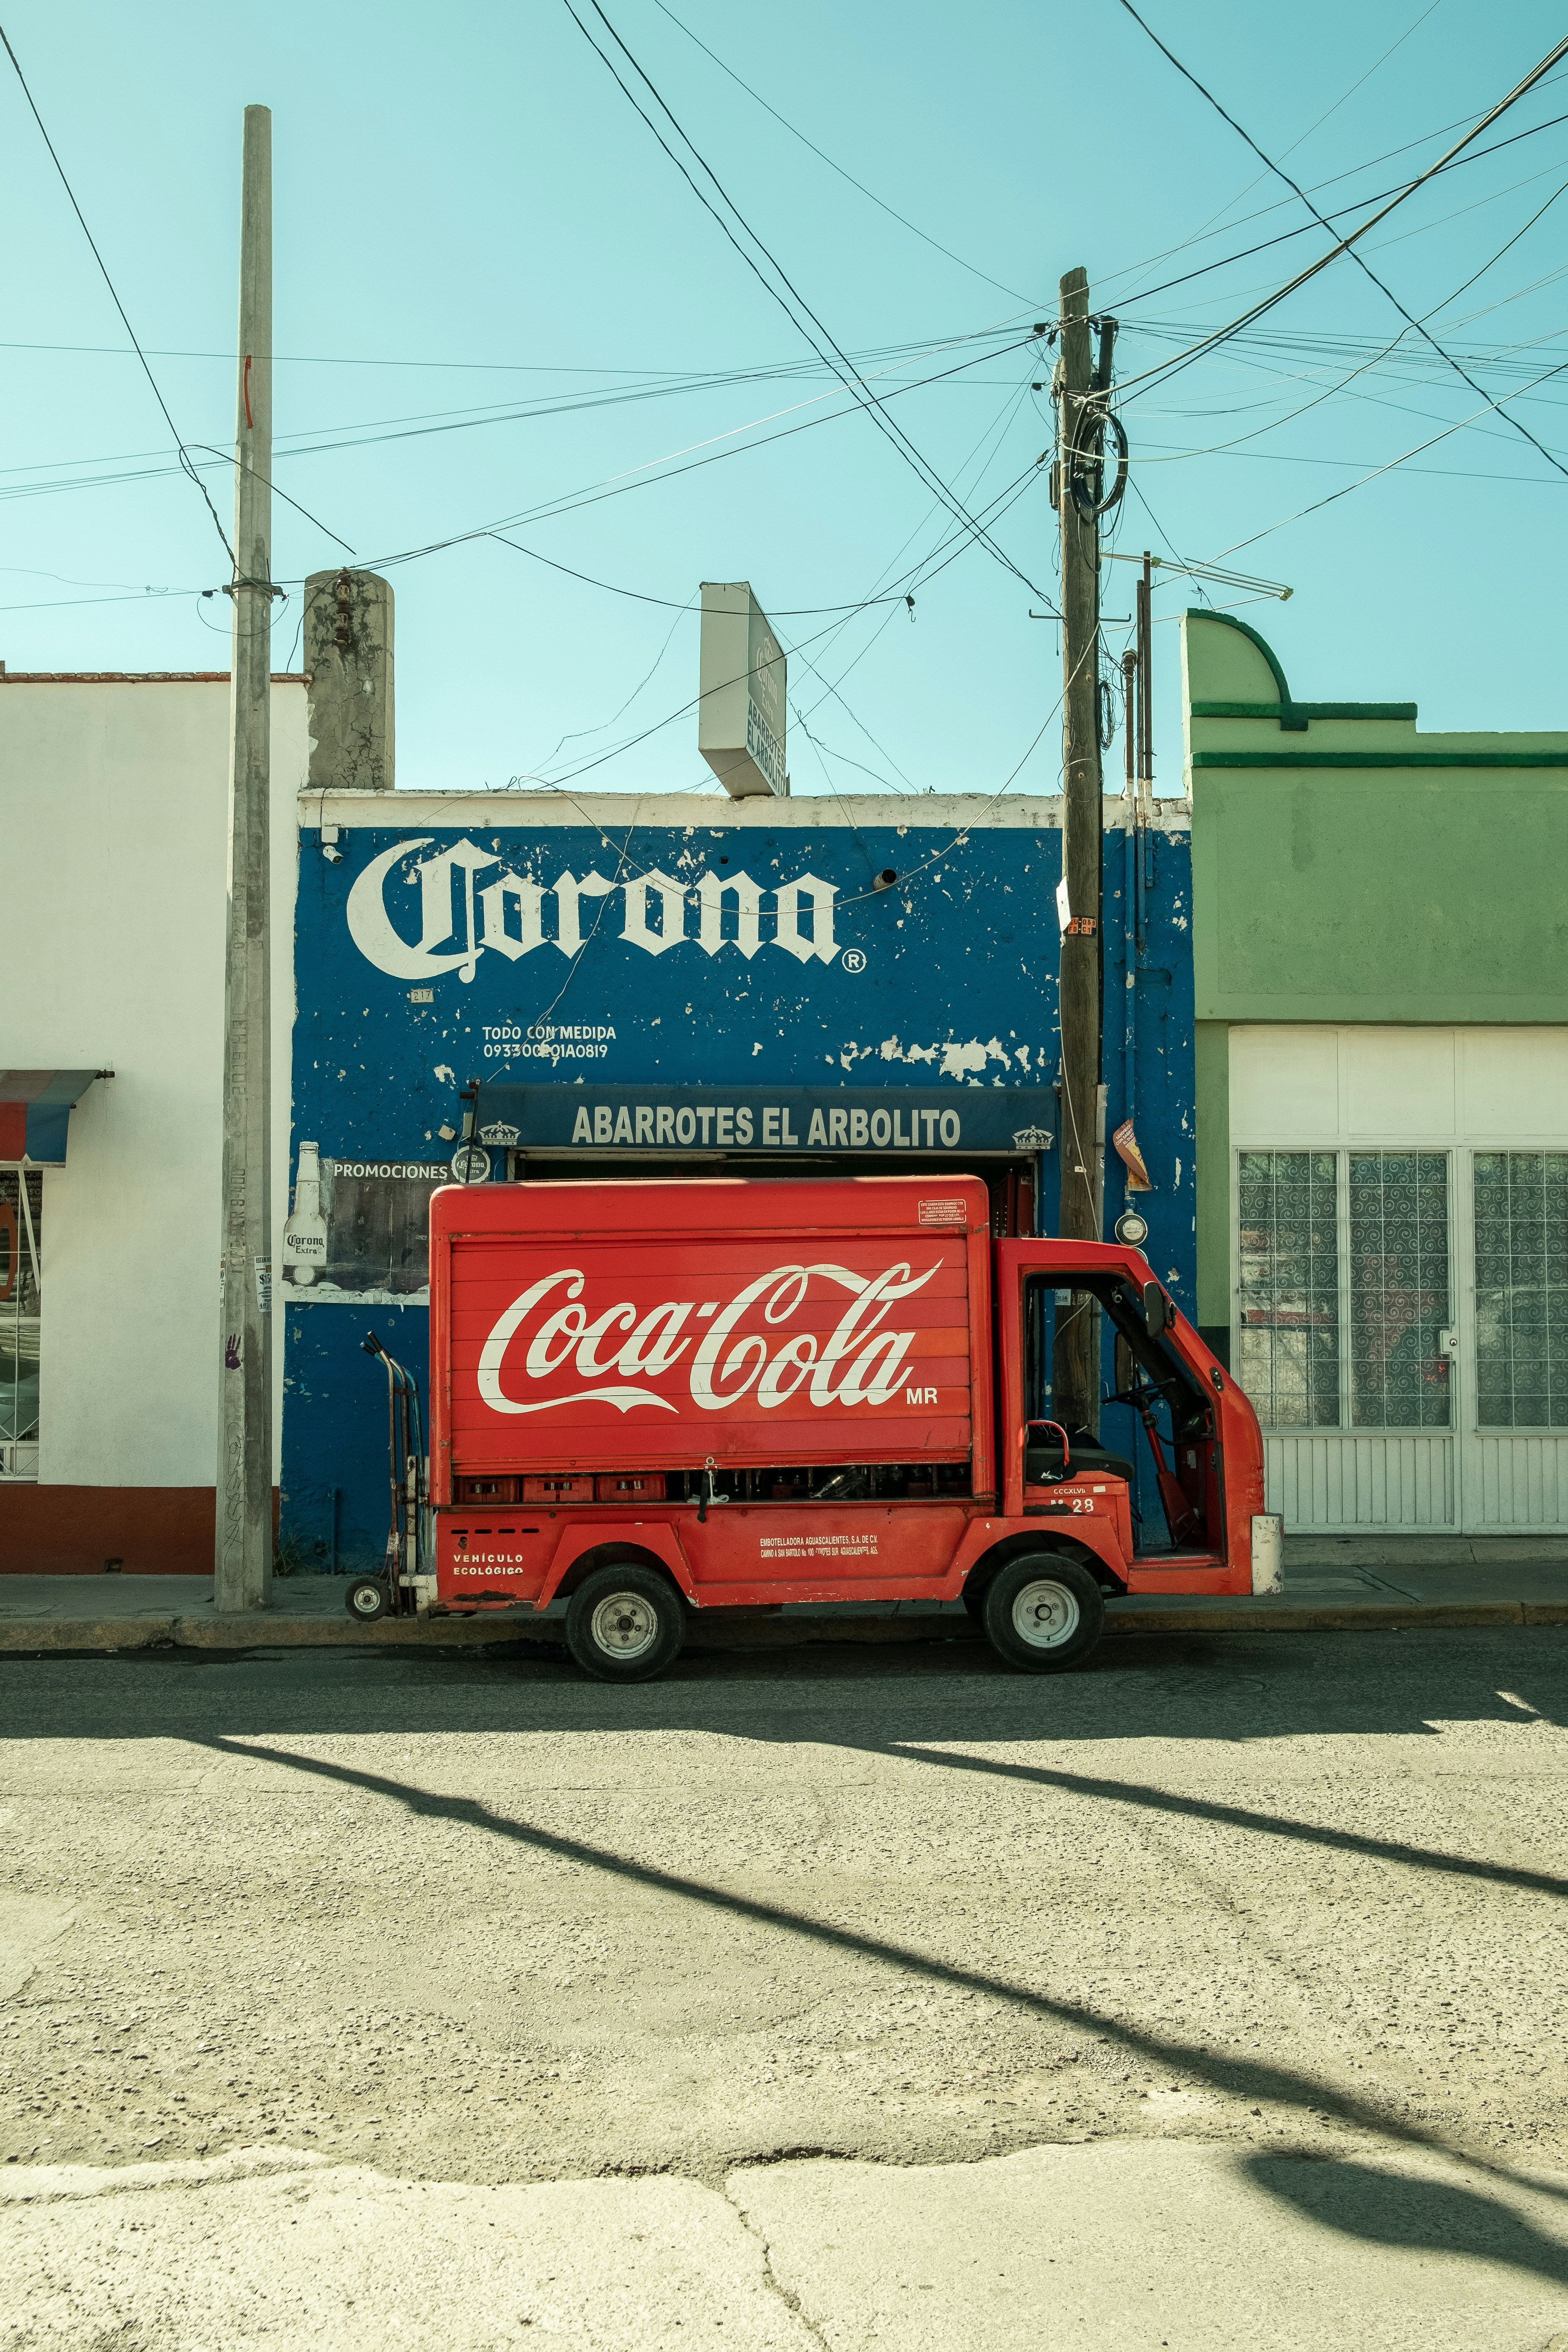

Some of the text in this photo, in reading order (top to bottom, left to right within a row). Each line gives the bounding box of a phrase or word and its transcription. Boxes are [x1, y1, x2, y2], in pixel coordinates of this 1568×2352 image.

[748, 698, 785, 772] ABARROTES
[748, 718, 784, 796] EL ARBOLITO
[347, 837, 842, 983] Corona
[414, 991, 431, 1000] 217
[482, 1026, 617, 1040] TODO CON MEDIDA
[572, 1106, 960, 1147] ABARROTES EL ARBOLITO
[457, 1160, 484, 1169] Coona
[334, 1164, 448, 1180] PROMOCIONES
[287, 1234, 323, 1248] Corona
[296, 1245, 317, 1254] Extra
[259, 1274, 272, 1285] $15
[477, 1257, 944, 1414] Coca-Cola
[907, 1387, 938, 1404] MR
[1072, 1498, 1094, 1513] 28
[760, 1537, 804, 1547] EMBOTELLADORA
[852, 1535, 861, 1544] S.A.
[862, 1535, 869, 1543] DE
[453, 1553, 523, 1562] VEHÍCULO
[760, 1549, 773, 1558] CAMINO
[775, 1549, 777, 1557] A
[786, 1548, 801, 1557] BARTOLO
[453, 1566, 523, 1575] ECOLÓGICO
